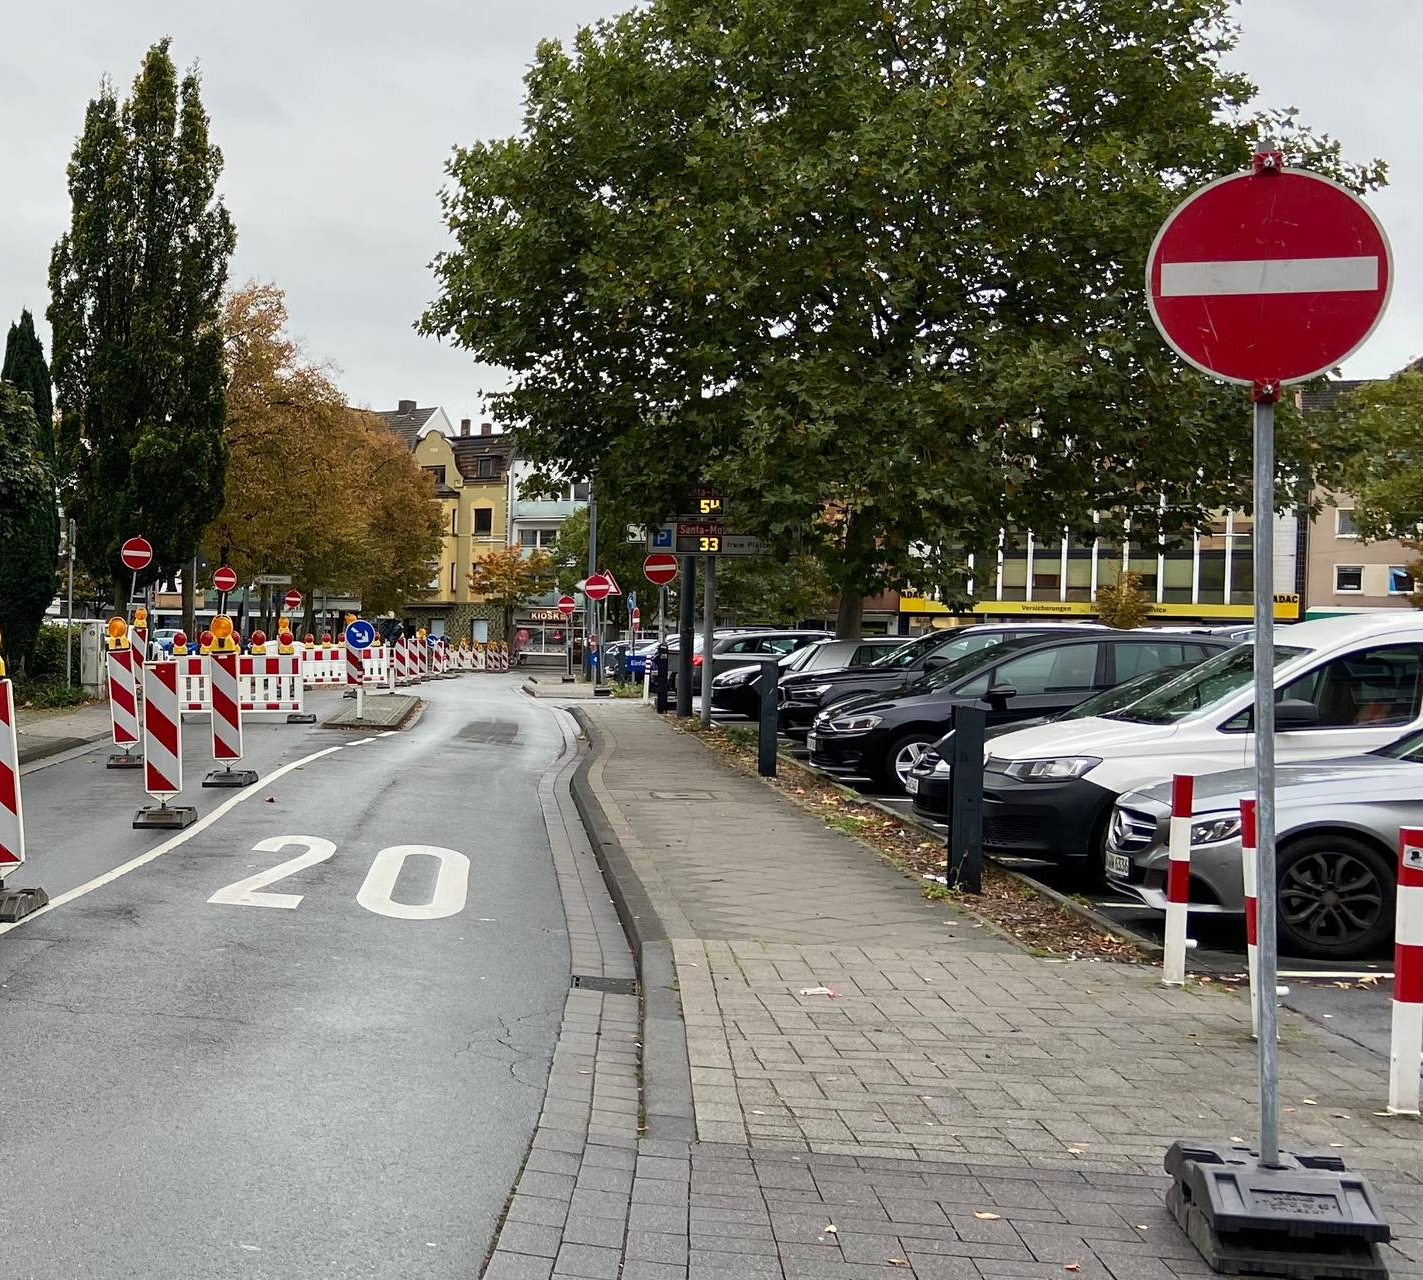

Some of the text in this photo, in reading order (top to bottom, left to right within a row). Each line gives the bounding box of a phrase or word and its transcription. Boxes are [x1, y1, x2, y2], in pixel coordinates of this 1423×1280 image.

[699, 537, 719, 551] 33
[901, 591, 924, 599] ADAC
[1273, 595, 1298, 604] ADAC
[1021, 605, 1072, 613] Versicherungen
[531, 611, 560, 620] KIOSK
[206, 834, 471, 919] 20
